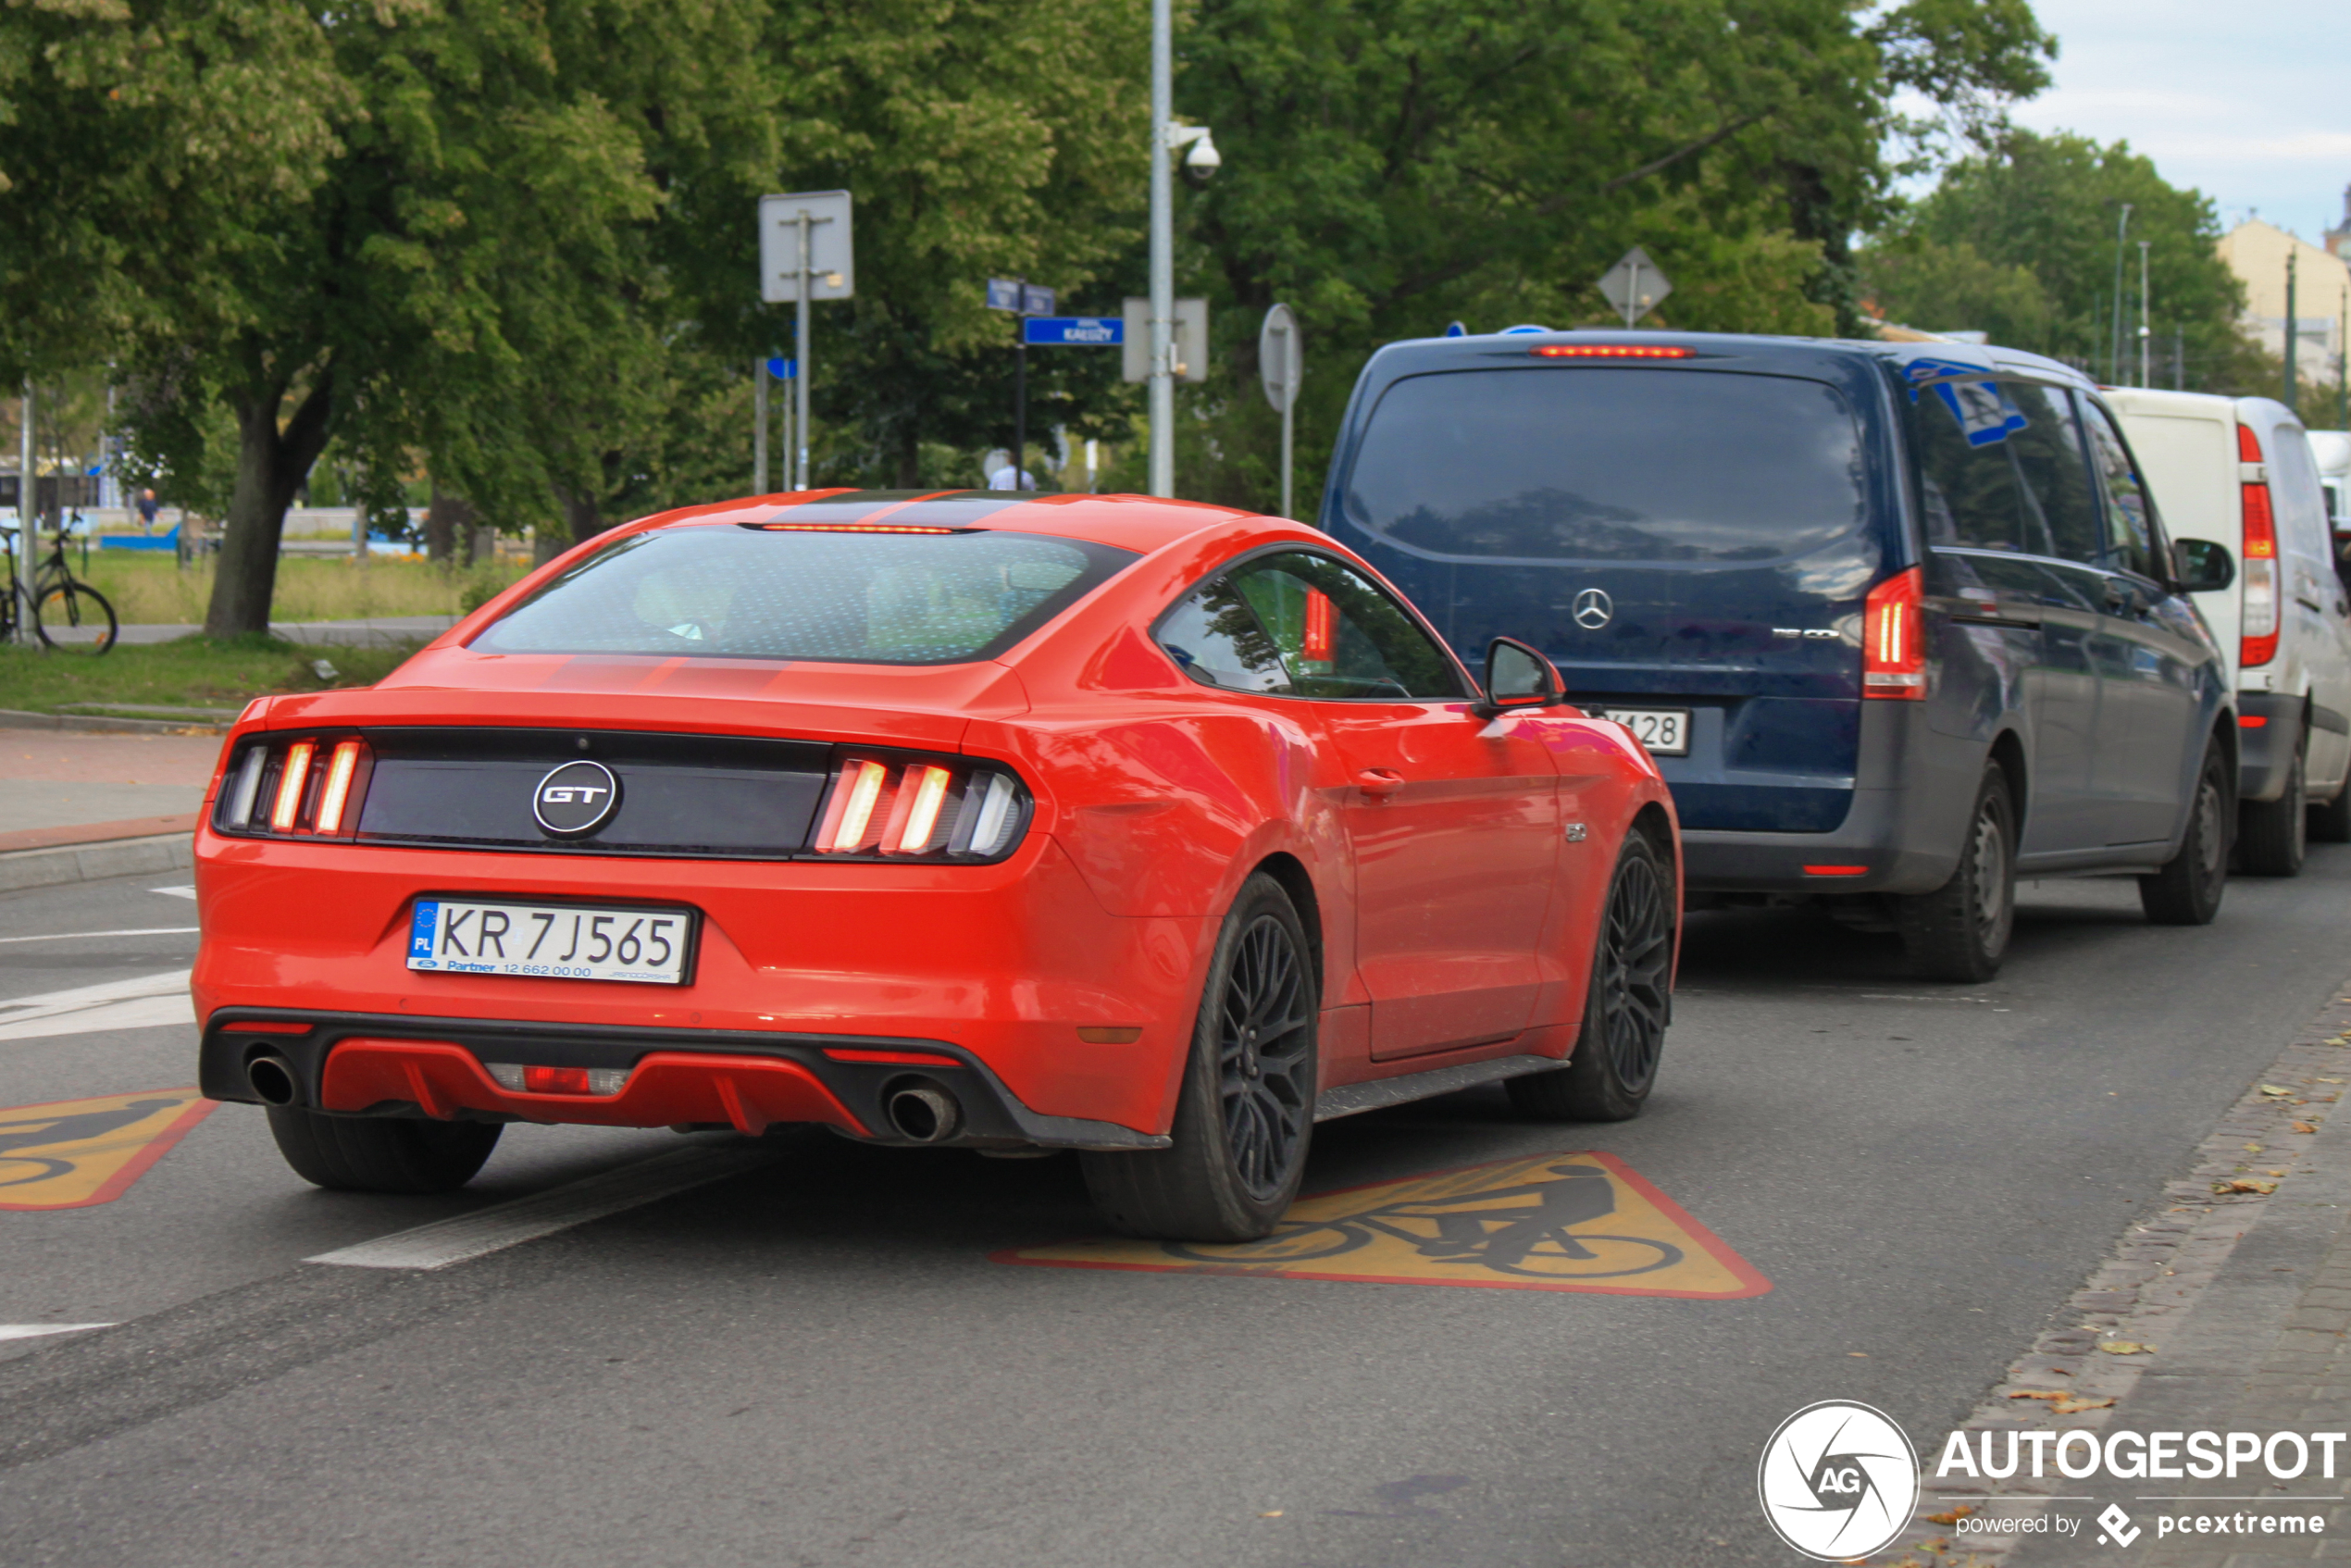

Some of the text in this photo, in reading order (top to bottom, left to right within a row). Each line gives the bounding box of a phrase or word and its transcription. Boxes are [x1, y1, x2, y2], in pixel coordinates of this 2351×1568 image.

[542, 786, 607, 803] GT
[414, 938, 431, 952] PL
[441, 907, 674, 967] KR 7J565
[447, 960, 496, 973] Partner
[504, 964, 518, 974] 12
[522, 964, 551, 976] 662
[553, 966, 571, 977] 00
[573, 967, 592, 977] 00
